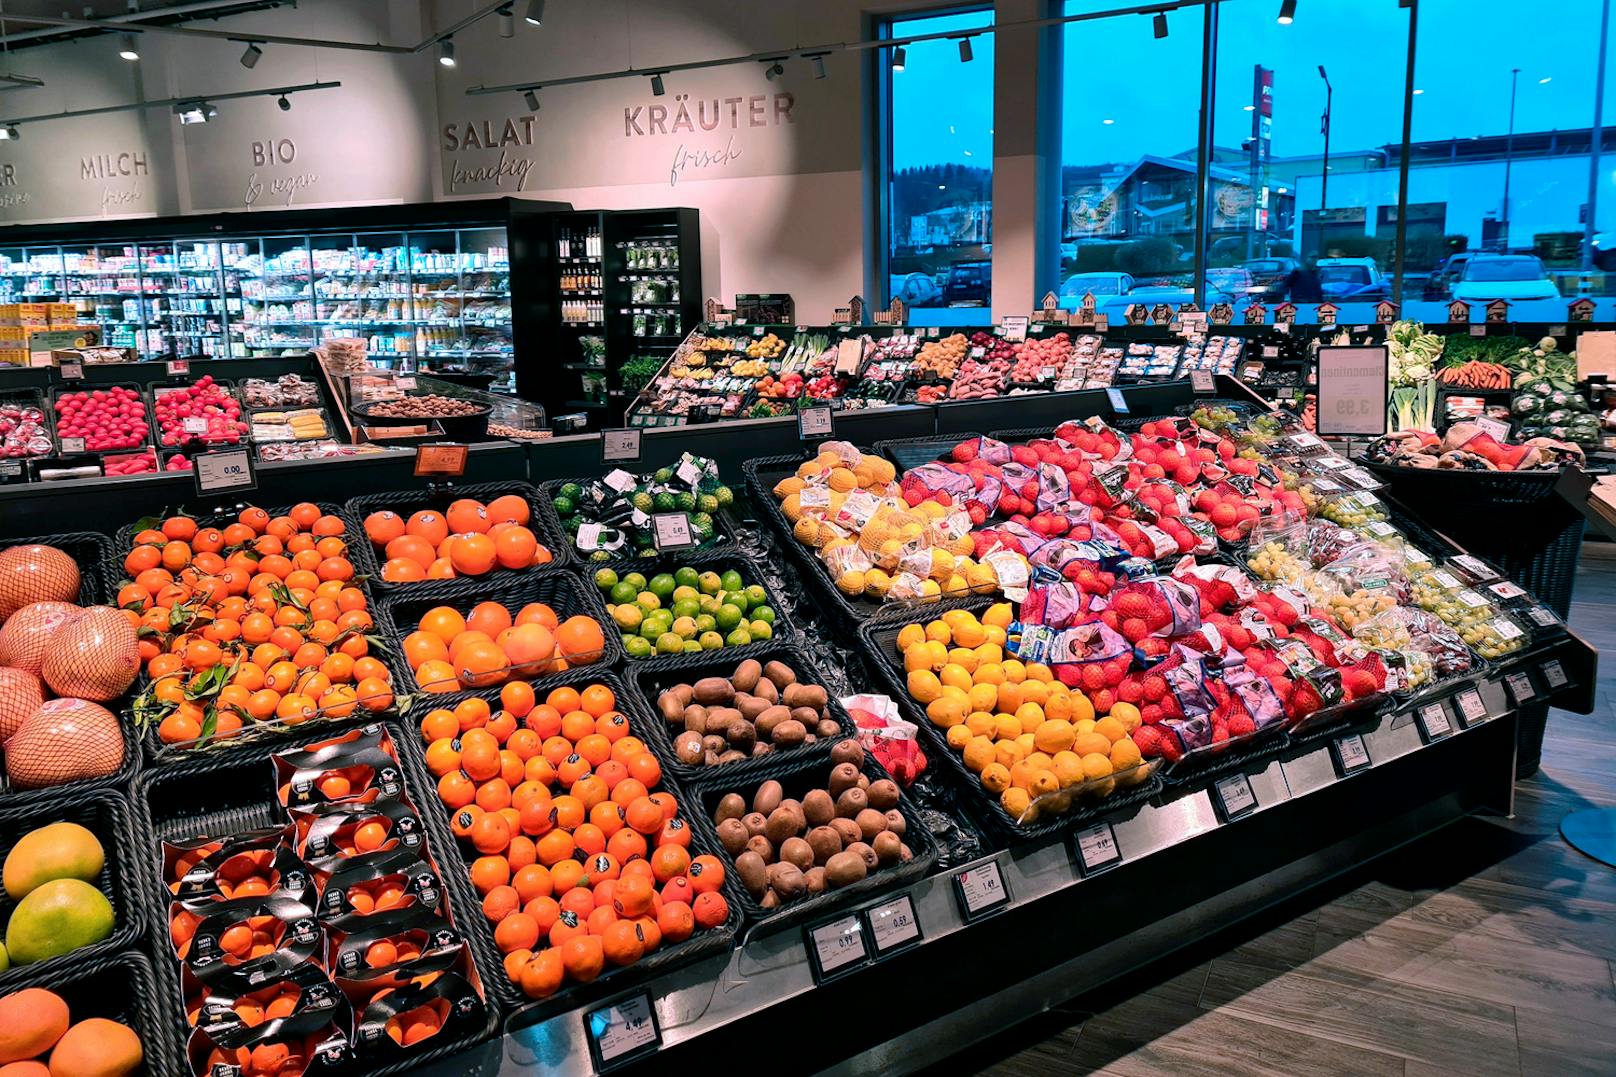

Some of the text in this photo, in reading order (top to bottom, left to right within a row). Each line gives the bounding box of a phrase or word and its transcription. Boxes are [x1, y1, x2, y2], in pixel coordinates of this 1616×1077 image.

[624, 92, 795, 137] KRÄUTER
[443, 116, 537, 152] SALAT
[80, 152, 149, 179] MILCH
[252, 138, 297, 167] BIO
[670, 135, 743, 187] frisch
[450, 149, 537, 193] knackig
[245, 173, 321, 211] & vegan
[224, 465, 241, 474] 0.00
[838, 934, 853, 948] 0.99
[625, 1016, 643, 1032] 4.49
